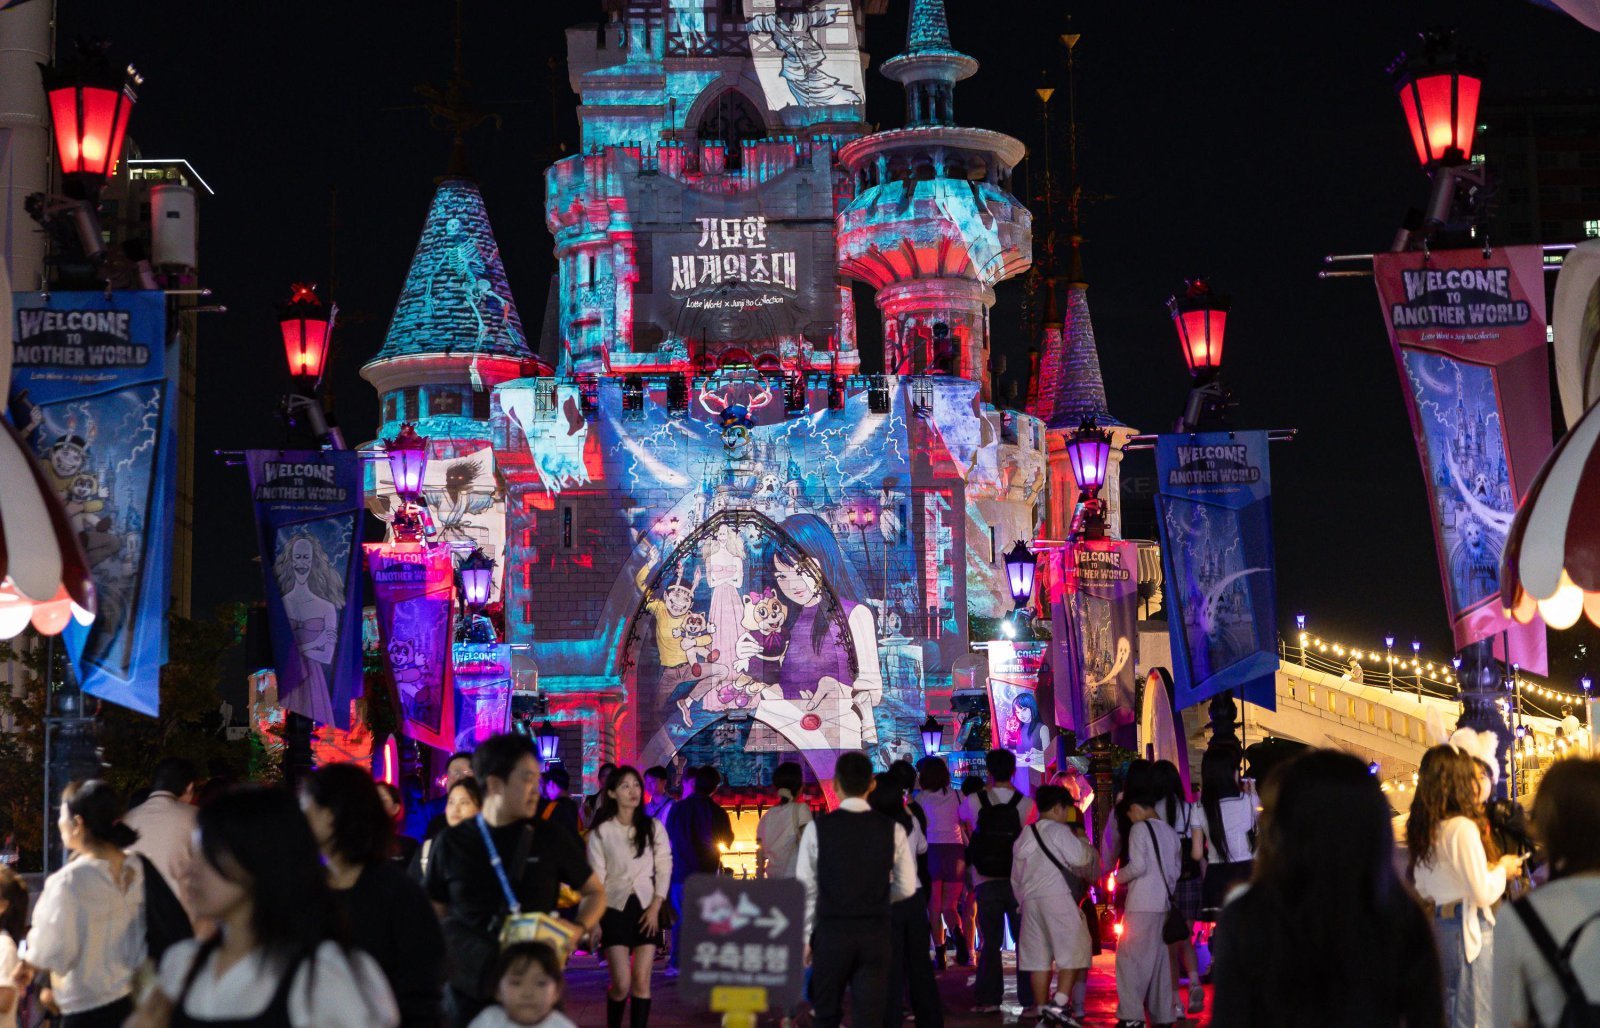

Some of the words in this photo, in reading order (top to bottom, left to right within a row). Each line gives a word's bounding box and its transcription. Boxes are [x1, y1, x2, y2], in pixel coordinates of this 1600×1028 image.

[696, 216, 767, 249] 기묘한
[1403, 269, 1508, 301] WELCOME
[1446, 291, 1461, 304] TO
[1393, 304, 1465, 326] ANOTHER
[1468, 301, 1529, 325] WORLD
[20, 310, 129, 341] WELCOME
[66, 333, 82, 345] TO
[13, 345, 85, 365] NOTHER
[88, 345, 149, 365] WORLD
[1177, 446, 1247, 466] WELCOME
[1206, 460, 1216, 469] TO
[265, 462, 335, 484] WELCOME
[1169, 470, 1218, 484] ANOTHER
[1219, 468, 1259, 484] WORLD
[256, 487, 305, 500] ANOTHER
[307, 487, 346, 501] WORLD
[1100, 569, 1128, 580] WORLD
